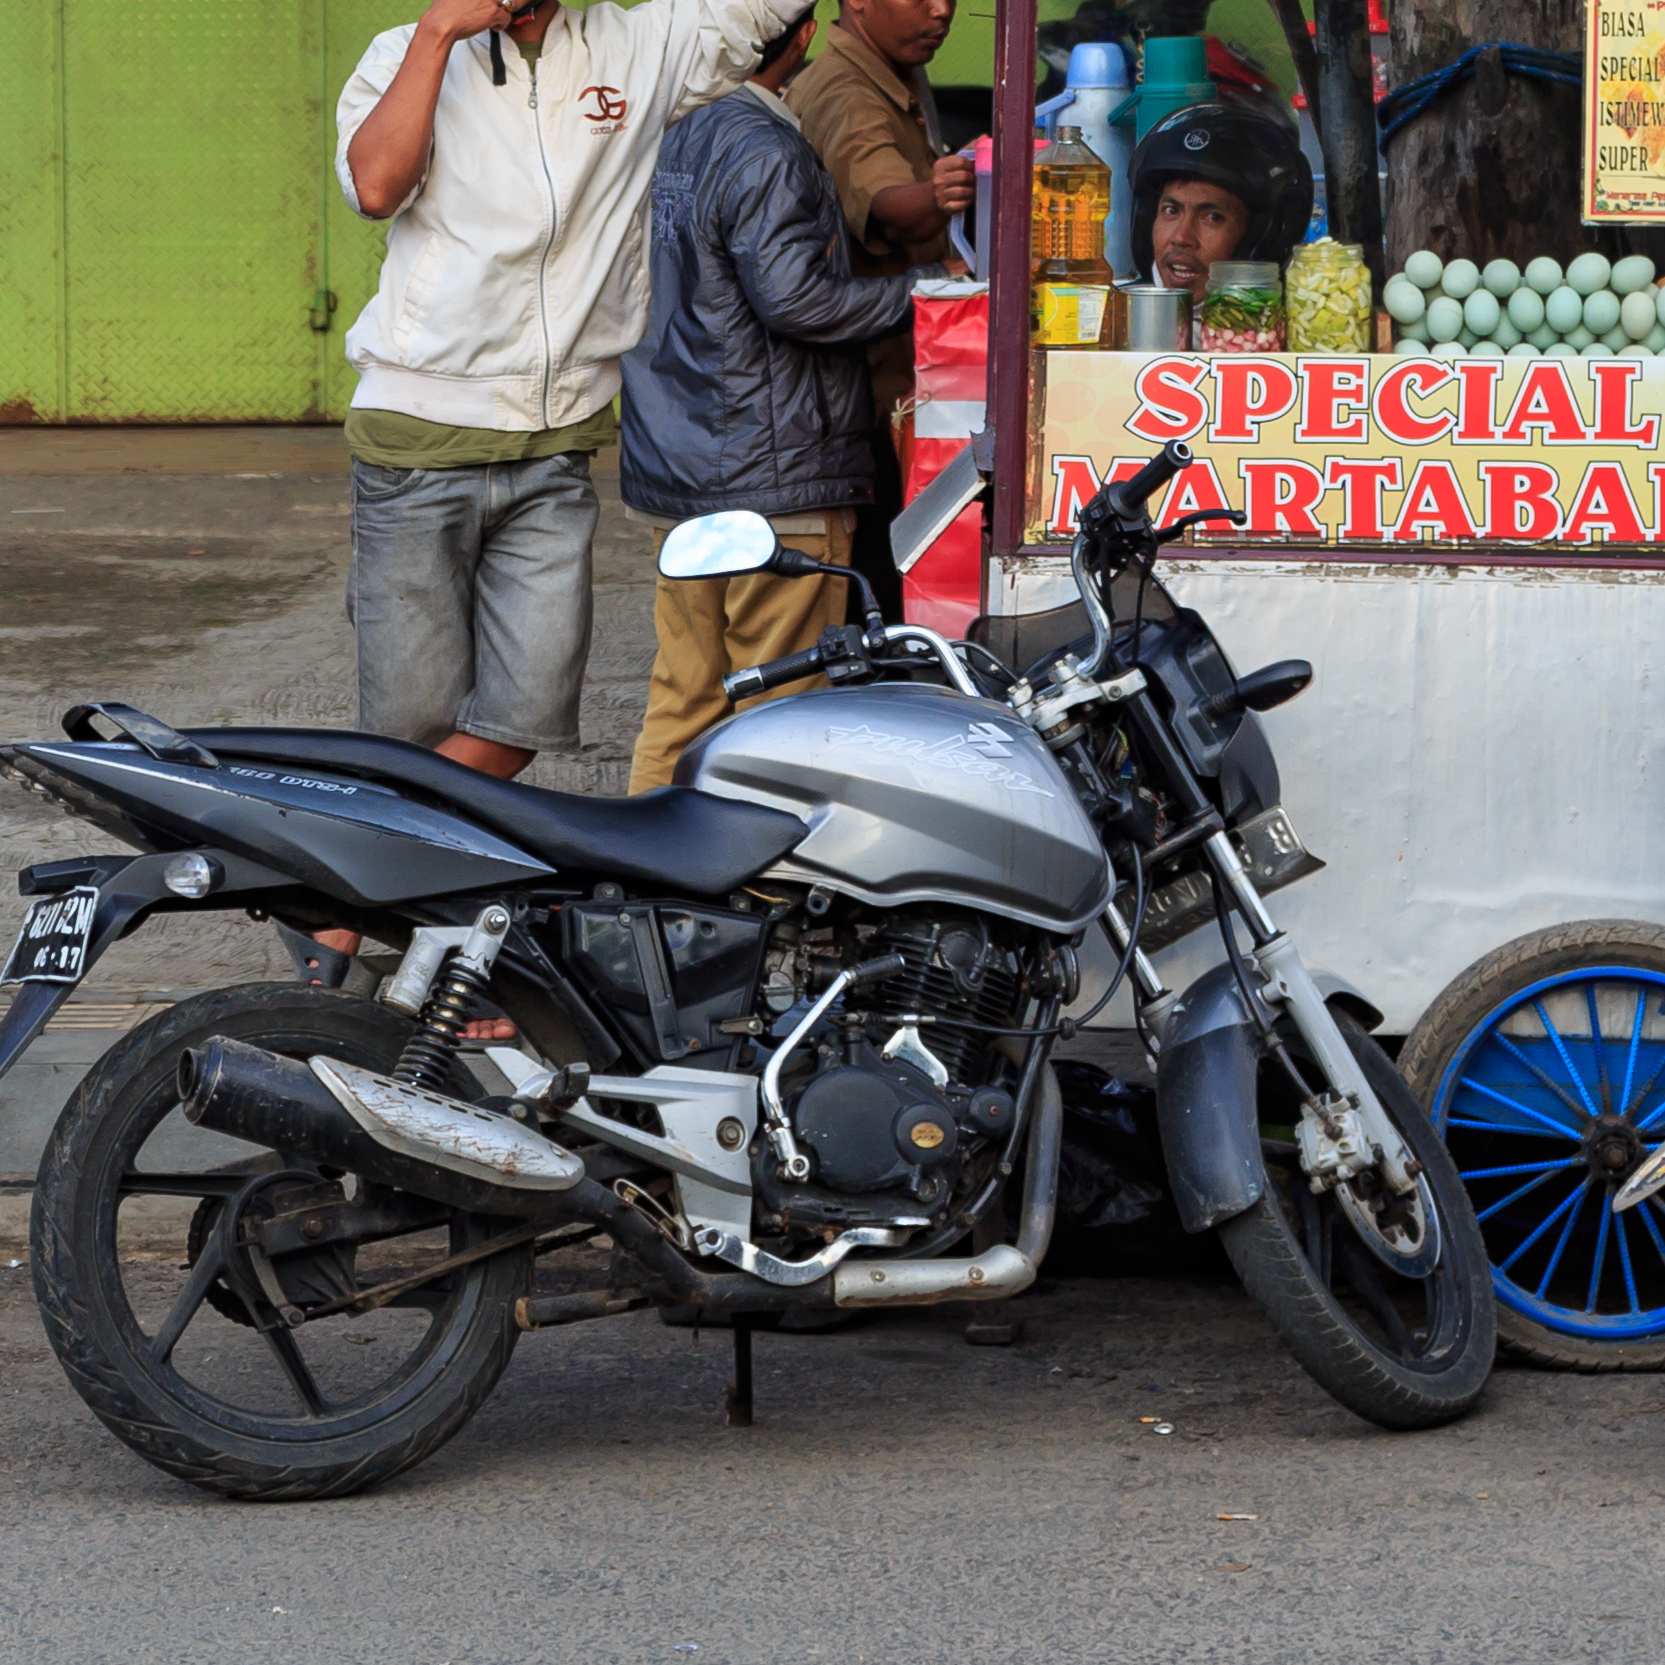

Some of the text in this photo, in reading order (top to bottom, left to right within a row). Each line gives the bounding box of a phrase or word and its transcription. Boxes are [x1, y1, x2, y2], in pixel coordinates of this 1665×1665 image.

[1601, 11, 1646, 37] BIASA
[1600, 56, 1661, 82] SPECIAL
[1599, 145, 1649, 171] SUPER
[1126, 356, 1662, 451] SPECIAL
